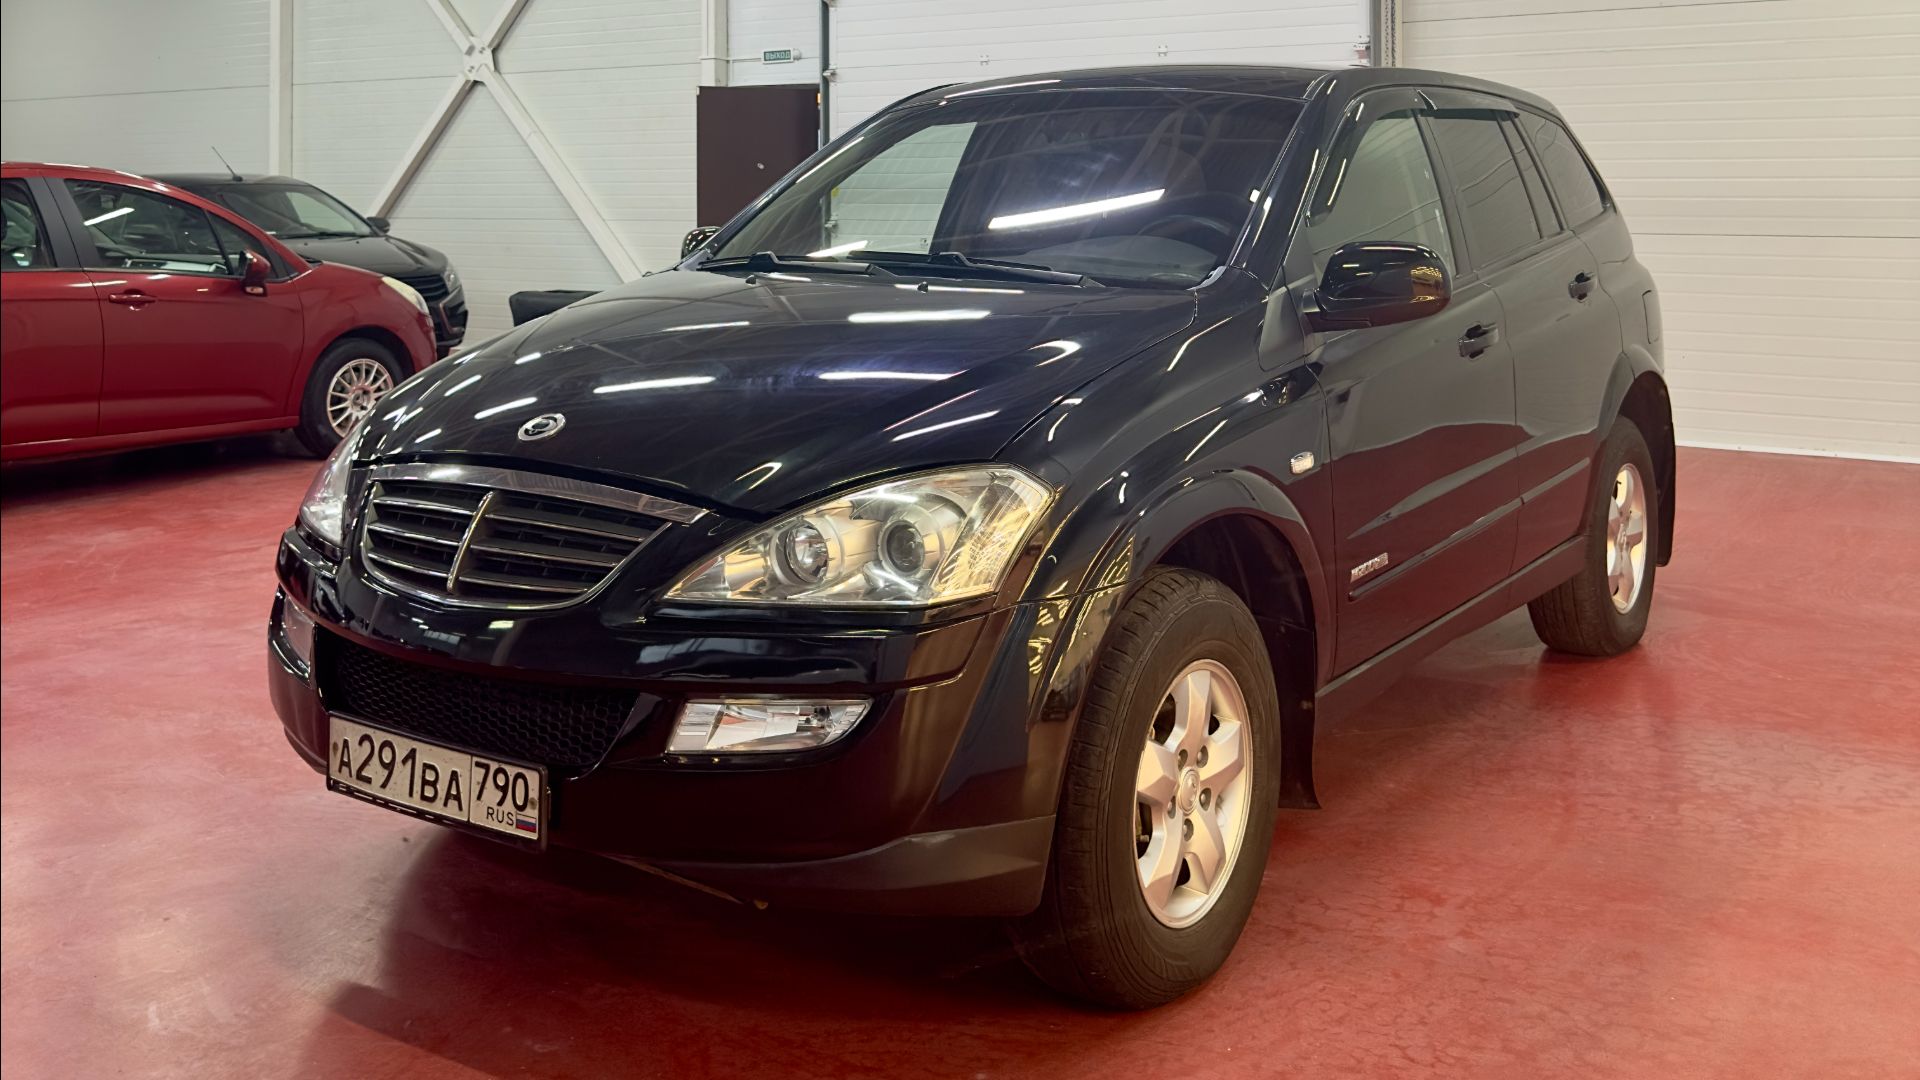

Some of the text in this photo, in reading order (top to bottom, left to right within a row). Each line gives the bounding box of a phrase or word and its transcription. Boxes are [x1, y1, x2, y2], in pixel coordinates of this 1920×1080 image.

[338, 734, 529, 811] А291ВА 790
[486, 807, 514, 826] RUS
